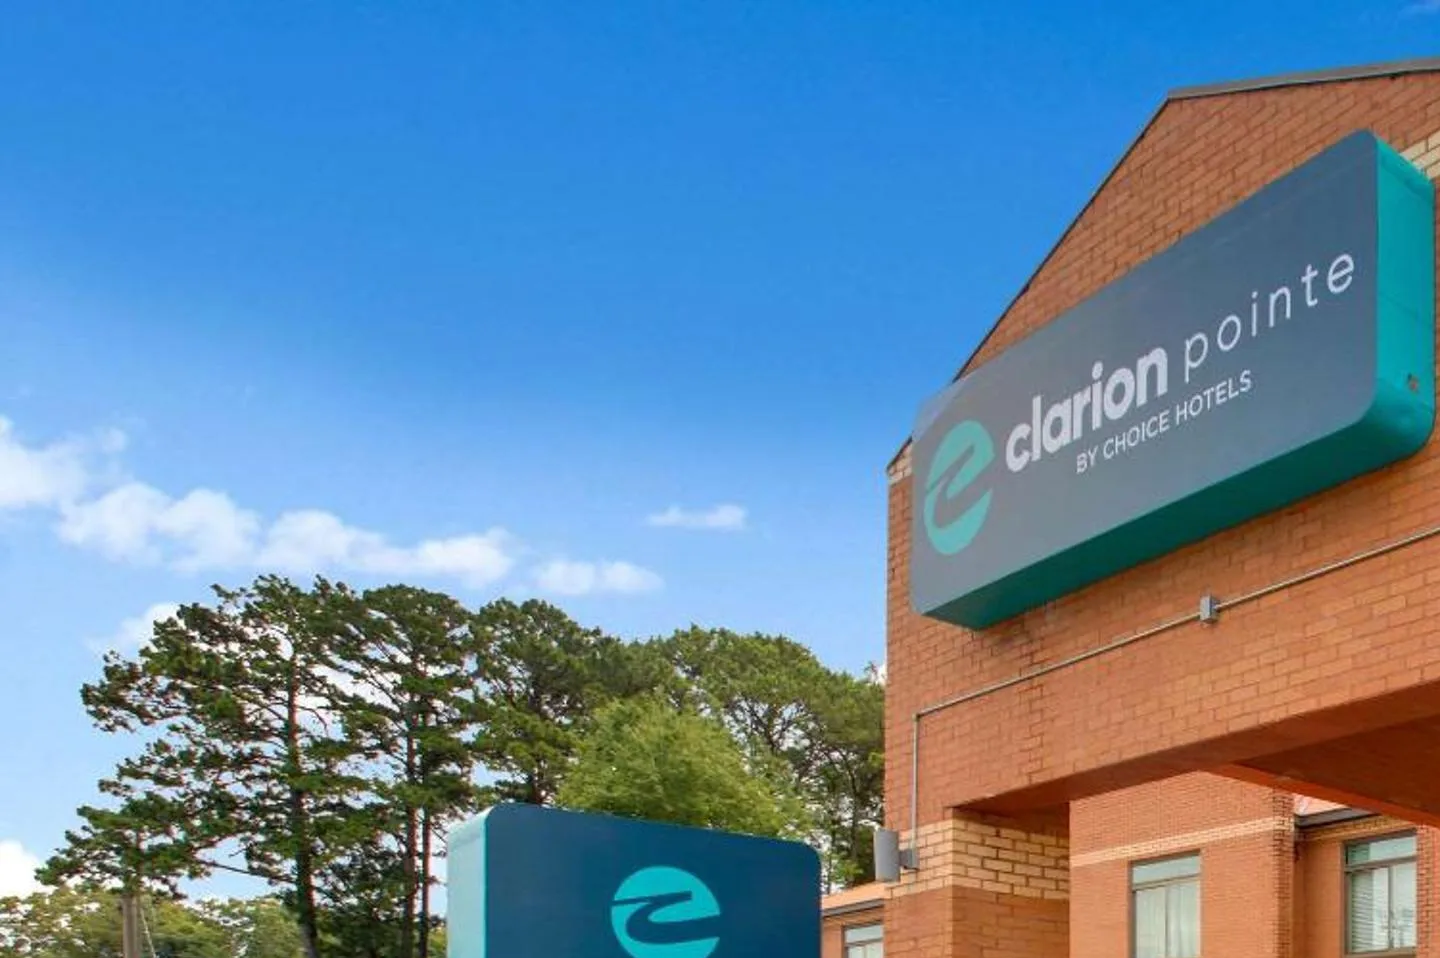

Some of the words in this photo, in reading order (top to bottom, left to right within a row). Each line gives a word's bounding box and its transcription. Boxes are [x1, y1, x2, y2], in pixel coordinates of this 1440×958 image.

[1005, 346, 1168, 473] clarion
[1183, 253, 1355, 384] pointe
[1076, 446, 1100, 474] BY
[1102, 410, 1170, 461] CHOICE
[1174, 369, 1253, 426] HOTELS
